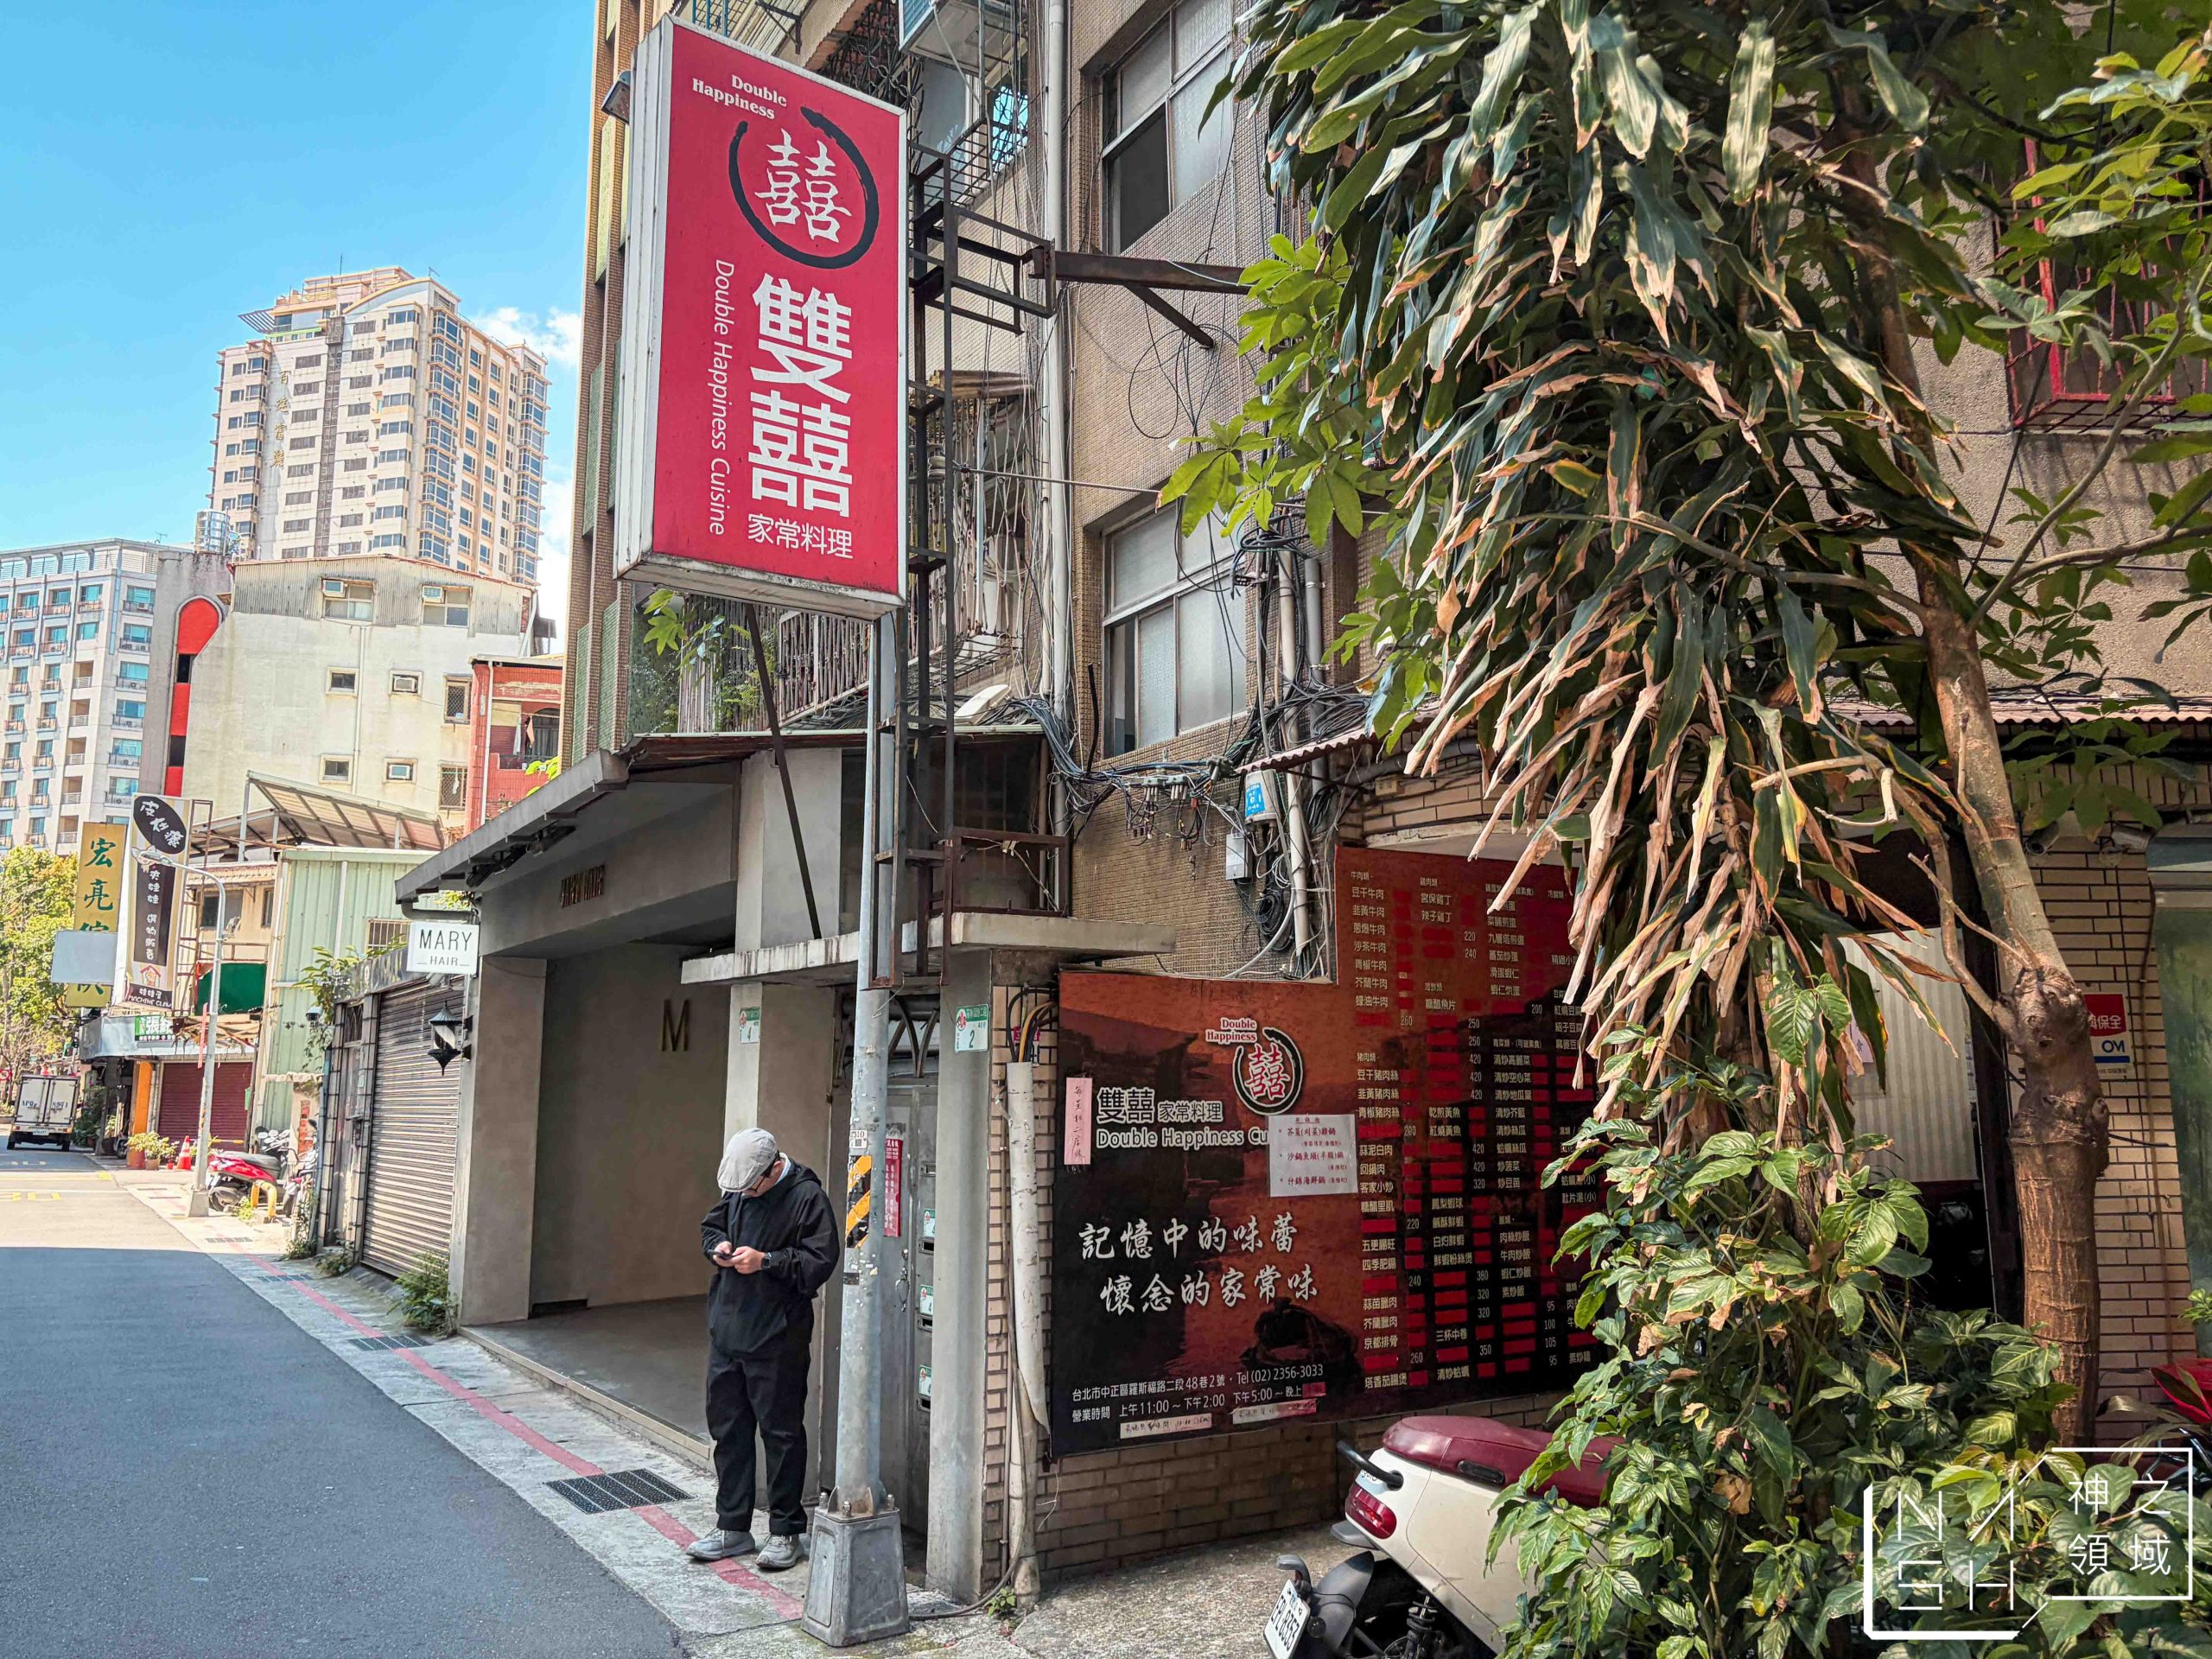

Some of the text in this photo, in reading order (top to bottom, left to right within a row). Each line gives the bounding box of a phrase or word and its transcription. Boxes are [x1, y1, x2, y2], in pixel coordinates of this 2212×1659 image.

[731, 74, 787, 107] Double
[692, 78, 776, 119] Happiness
[708, 259, 735, 535] Double Happiness Cuisine
[747, 512, 853, 558] 家常料理
[1351, 887, 1383, 899] 豆干牛肉
[1352, 906, 1384, 918] 韭黃牛肉
[419, 929, 473, 951] MARY
[1464, 931, 1476, 942] 220
[1354, 941, 1386, 953] 沙茶牛肉
[1465, 948, 1477, 959] 240
[429, 956, 458, 967] HAIR
[1355, 959, 1387, 971] 青椒牛肉
[1531, 1003, 1542, 1014] 200
[662, 999, 689, 1052] M
[1221, 1018, 1257, 1030] Double
[1468, 1018, 1479, 1028] 250
[969, 1030, 975, 1048] 2
[1205, 1030, 1257, 1045] Happiness
[1469, 1036, 1480, 1046] 250
[1469, 1054, 1481, 1065] 420
[1357, 1070, 1398, 1081] 豆干豬肉絲
[1470, 1071, 1482, 1082] 420
[1357, 1088, 1399, 1099] 韭黃豬肉絲
[1471, 1090, 1483, 1100] 420
[1158, 1100, 1223, 1122] 家常料理
[1096, 1127, 1269, 1150] Double Happiness Cu
[1472, 1143, 1484, 1154] 420
[1360, 1163, 1385, 1175] 回鍋肉
[1473, 1161, 1485, 1172] 420
[1360, 1181, 1393, 1193] 客家小炒
[1473, 1179, 1485, 1189] 320
[1407, 1217, 1419, 1230] 220
[1079, 1211, 1297, 1260] 記憶中的味蕾
[1500, 1249, 1530, 1261] 牛肉炒飯
[1408, 1275, 1421, 1287] 240
[1100, 1263, 1317, 1316] 懷念的家常味
[1478, 1288, 1490, 1300] 320
[1547, 1300, 1555, 1312] 95
[1478, 1306, 1490, 1319] 320
[1544, 1319, 1556, 1330] 100
[1545, 1337, 1556, 1348] 105
[1479, 1344, 1491, 1356] 350
[1410, 1352, 1423, 1363] 260
[1549, 1355, 1558, 1366] 95
[1236, 1372, 1249, 1384] Tel
[1251, 1369, 1271, 1383] (02)
[1273, 1364, 1324, 1380] 2356-3033
[1072, 1406, 1110, 1422] 營業時間
[1286, 1386, 1302, 1397] 晚上
